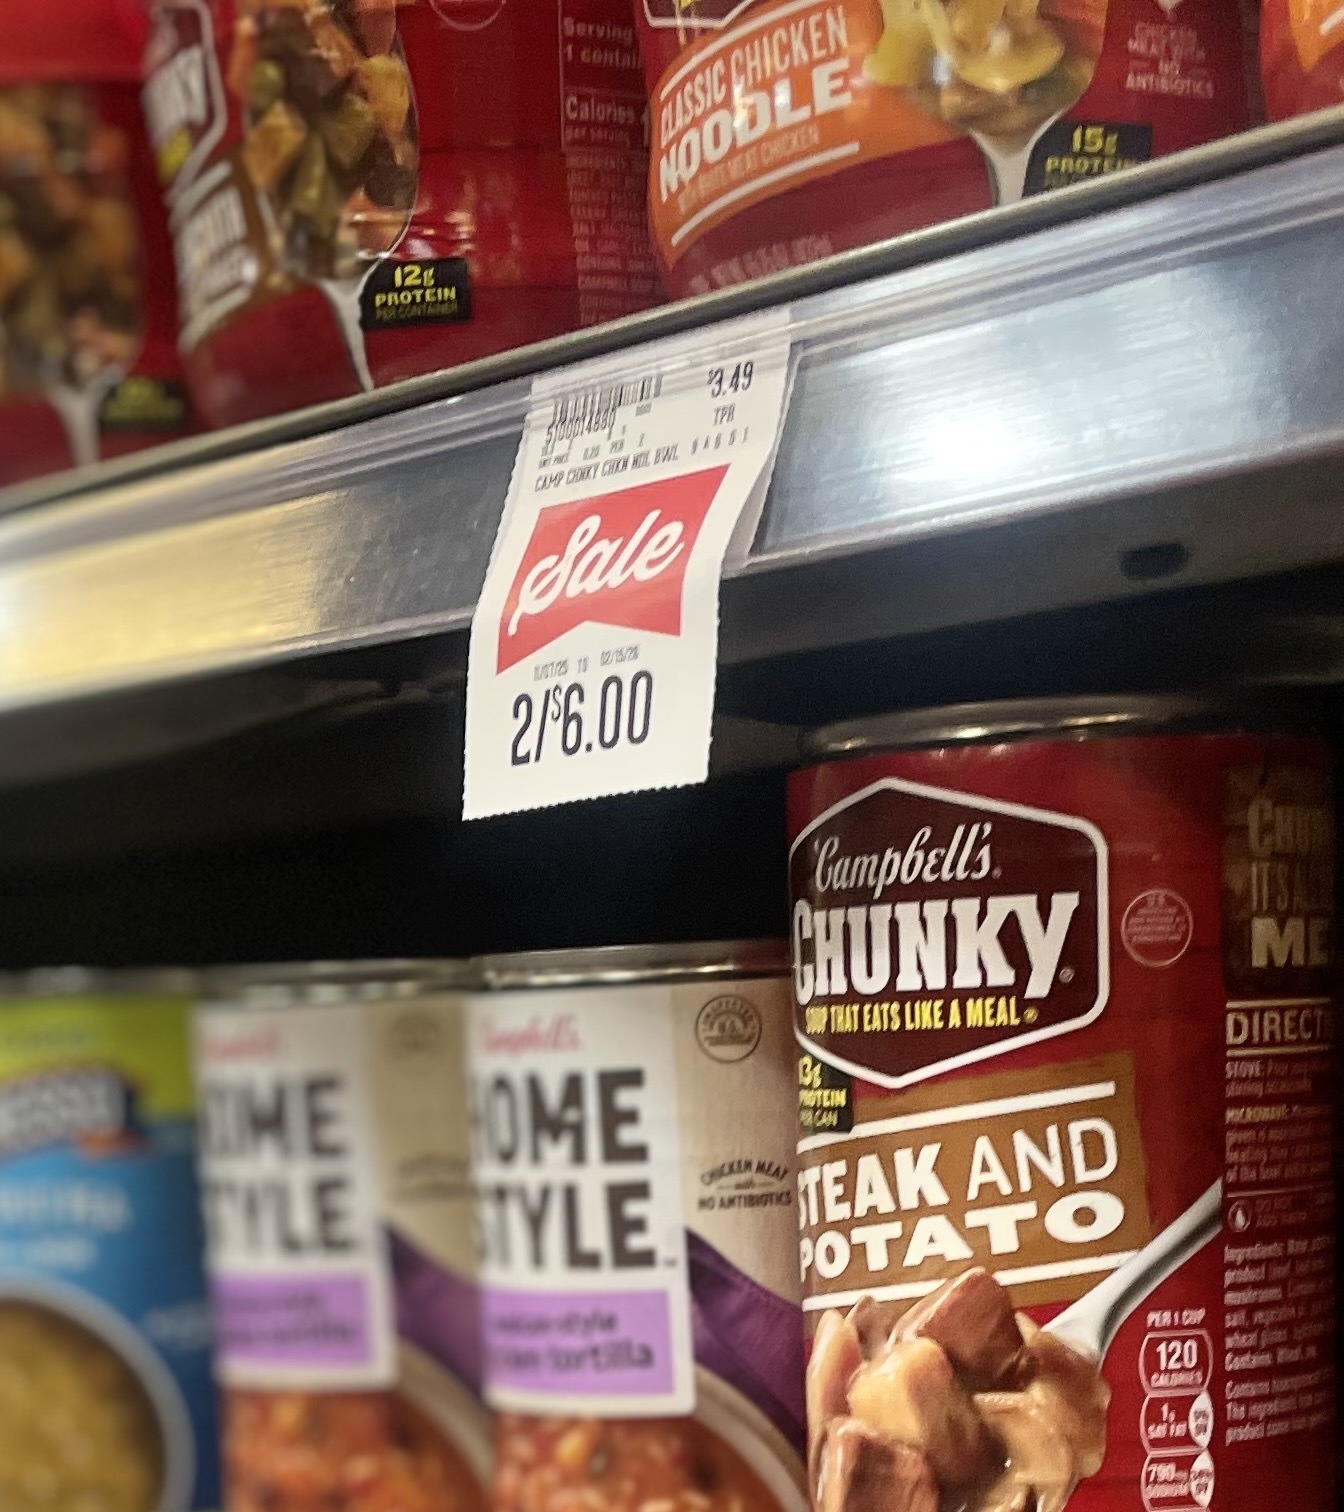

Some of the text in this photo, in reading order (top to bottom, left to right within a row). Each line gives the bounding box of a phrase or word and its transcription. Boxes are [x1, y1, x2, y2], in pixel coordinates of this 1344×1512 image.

[659, 3, 850, 151] CLASSIC CHICKEN
[659, 56, 853, 204] NOODLE
[374, 286, 457, 307] PROTEIN
[394, 264, 436, 288] 12g
[534, 470, 566, 493] CAMP
[506, 508, 685, 638] Sale
[814, 819, 995, 899] Campbell's
[792, 889, 1081, 1007] CHUNKY
[805, 994, 1022, 1036] SOUP THAT EATS LIKE A MEAL
[1224, 1008, 1331, 1046] DIRECT
[966, 1117, 1120, 1199] AND
[799, 1190, 1127, 1284] POTATO
[1155, 1338, 1199, 1371] 120
